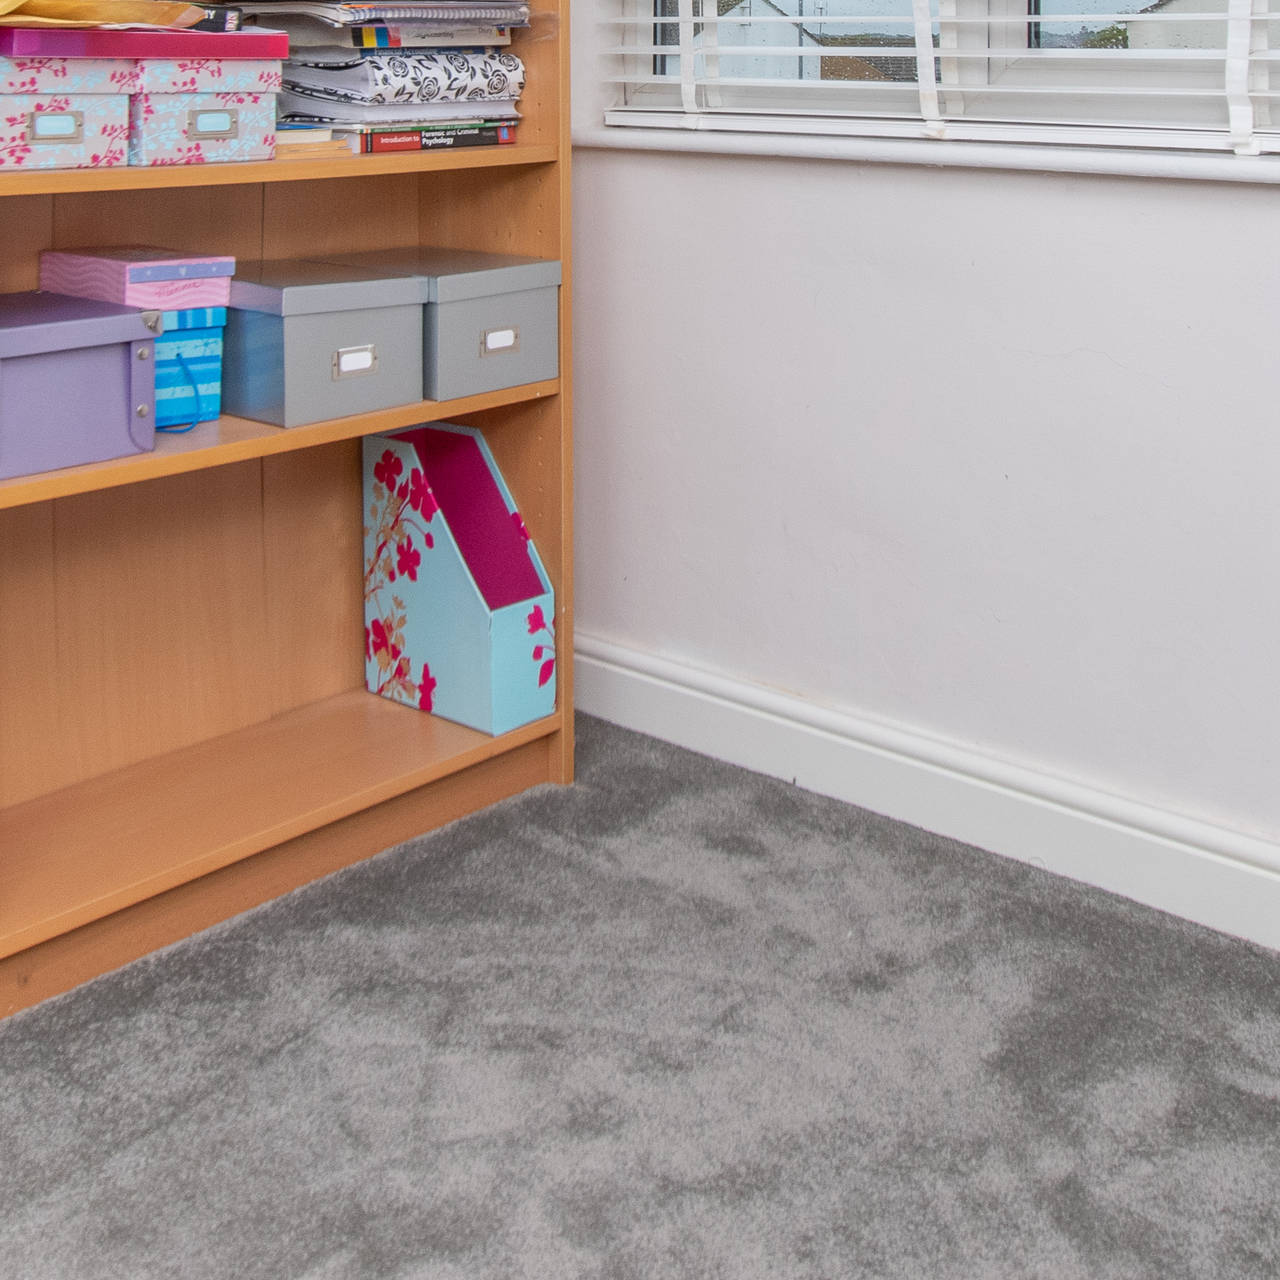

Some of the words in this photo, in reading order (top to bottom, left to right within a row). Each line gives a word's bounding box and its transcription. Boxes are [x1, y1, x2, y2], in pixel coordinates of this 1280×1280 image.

[422, 130, 445, 138] Forensic
[457, 127, 479, 136] Criminal
[380, 136, 412, 144] Introduction
[422, 136, 454, 146] Psychology
